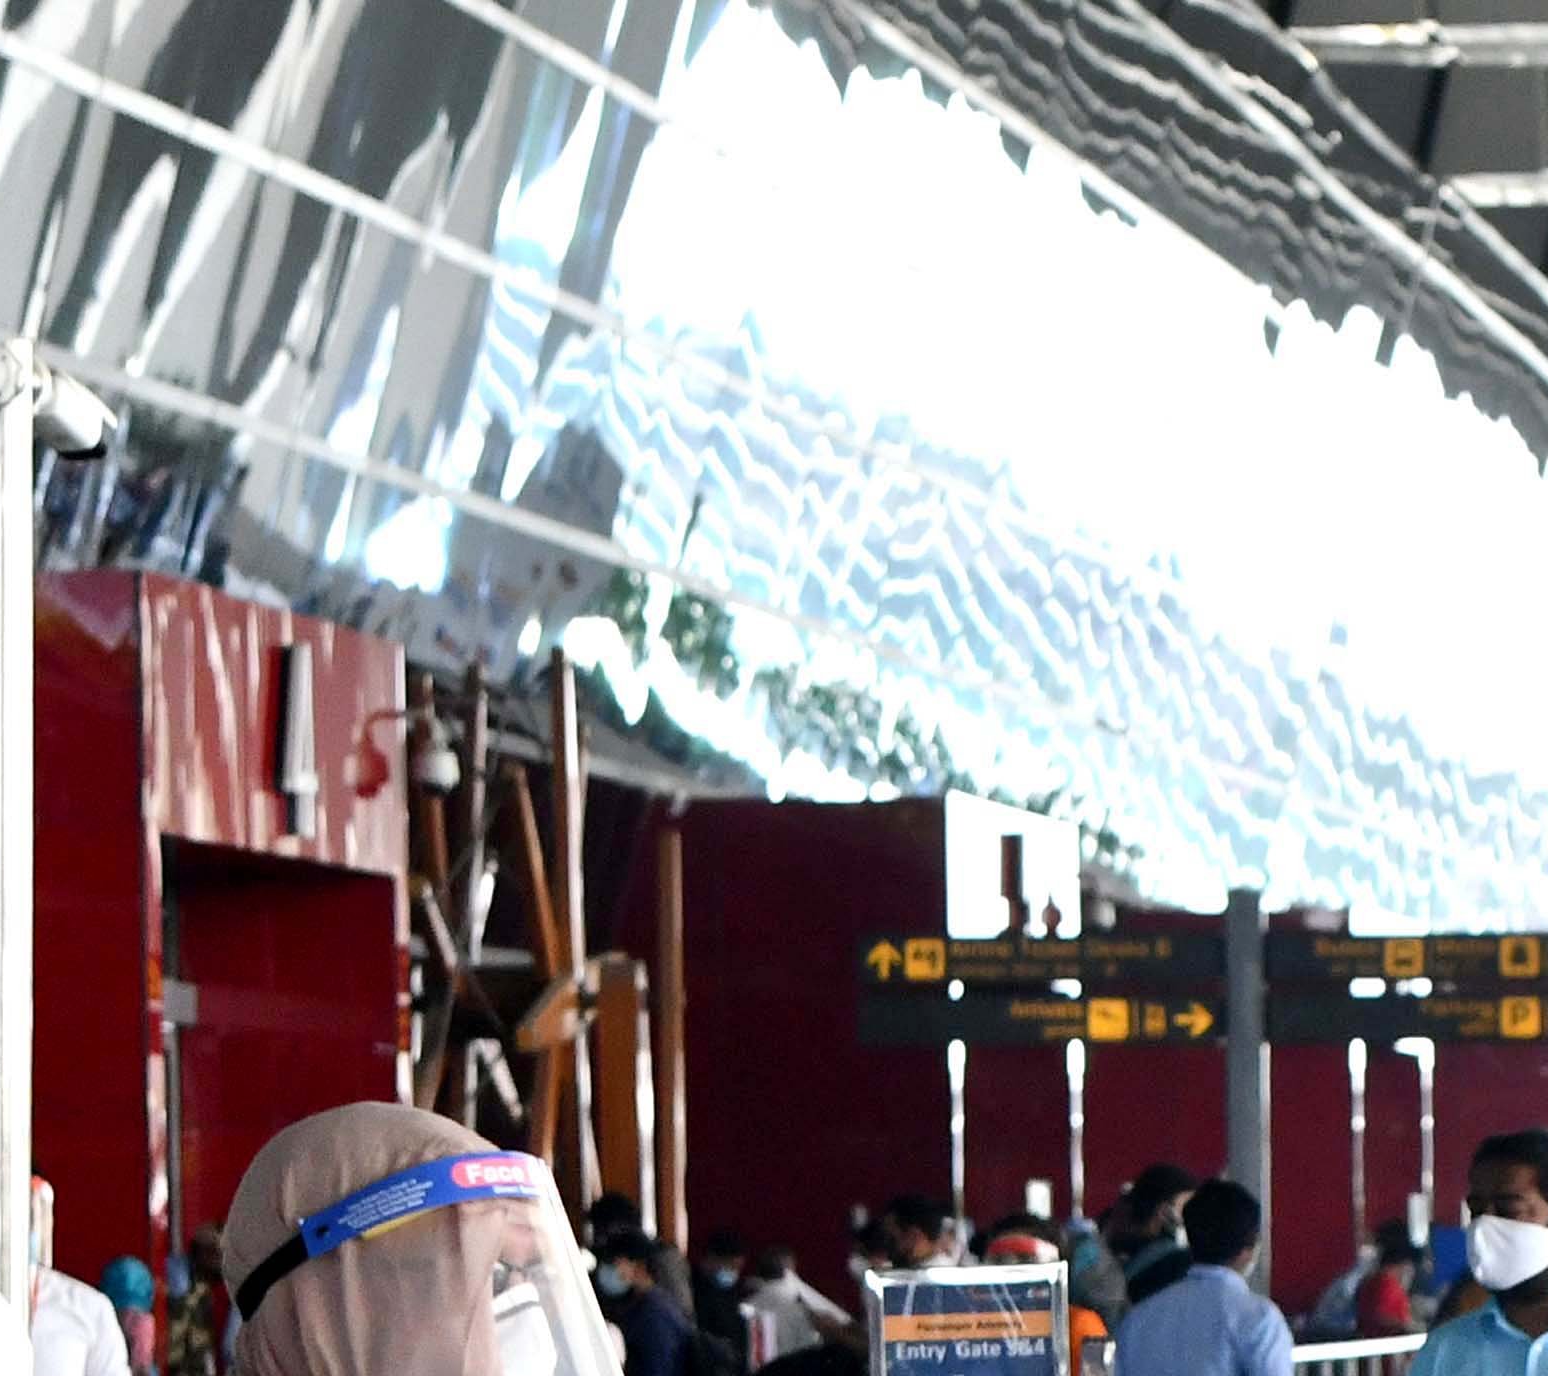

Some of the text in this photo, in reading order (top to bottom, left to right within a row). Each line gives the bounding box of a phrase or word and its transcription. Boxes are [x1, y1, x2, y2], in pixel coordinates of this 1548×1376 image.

[465, 1162, 525, 1186] Face
[896, 1342, 946, 1364] Entry
[955, 1341, 1002, 1359] Gate
